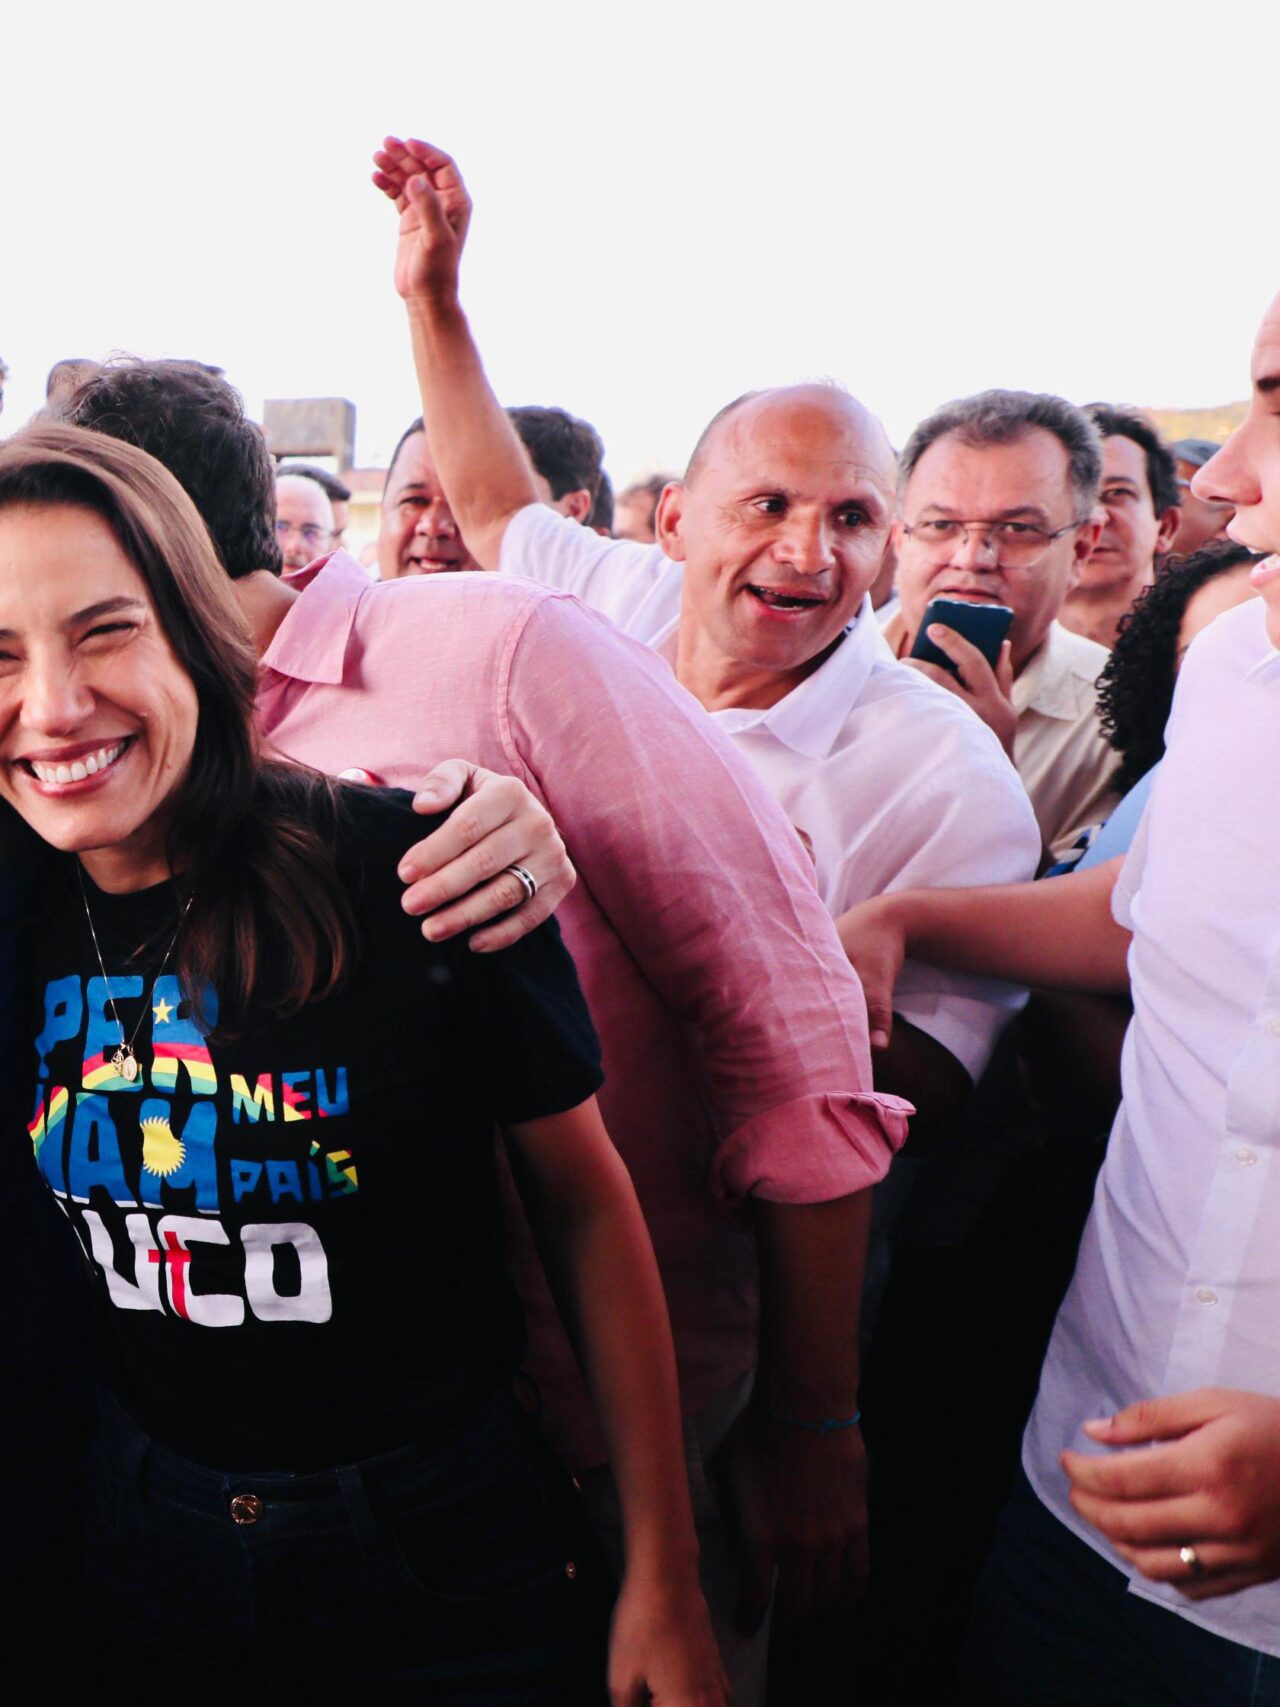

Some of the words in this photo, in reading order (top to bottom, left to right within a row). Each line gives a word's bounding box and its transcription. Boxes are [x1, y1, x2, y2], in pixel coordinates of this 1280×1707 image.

[34, 974, 219, 1095] PER
[229, 1066, 350, 1125] MEU
[229, 1139, 360, 1205] PAÍS
